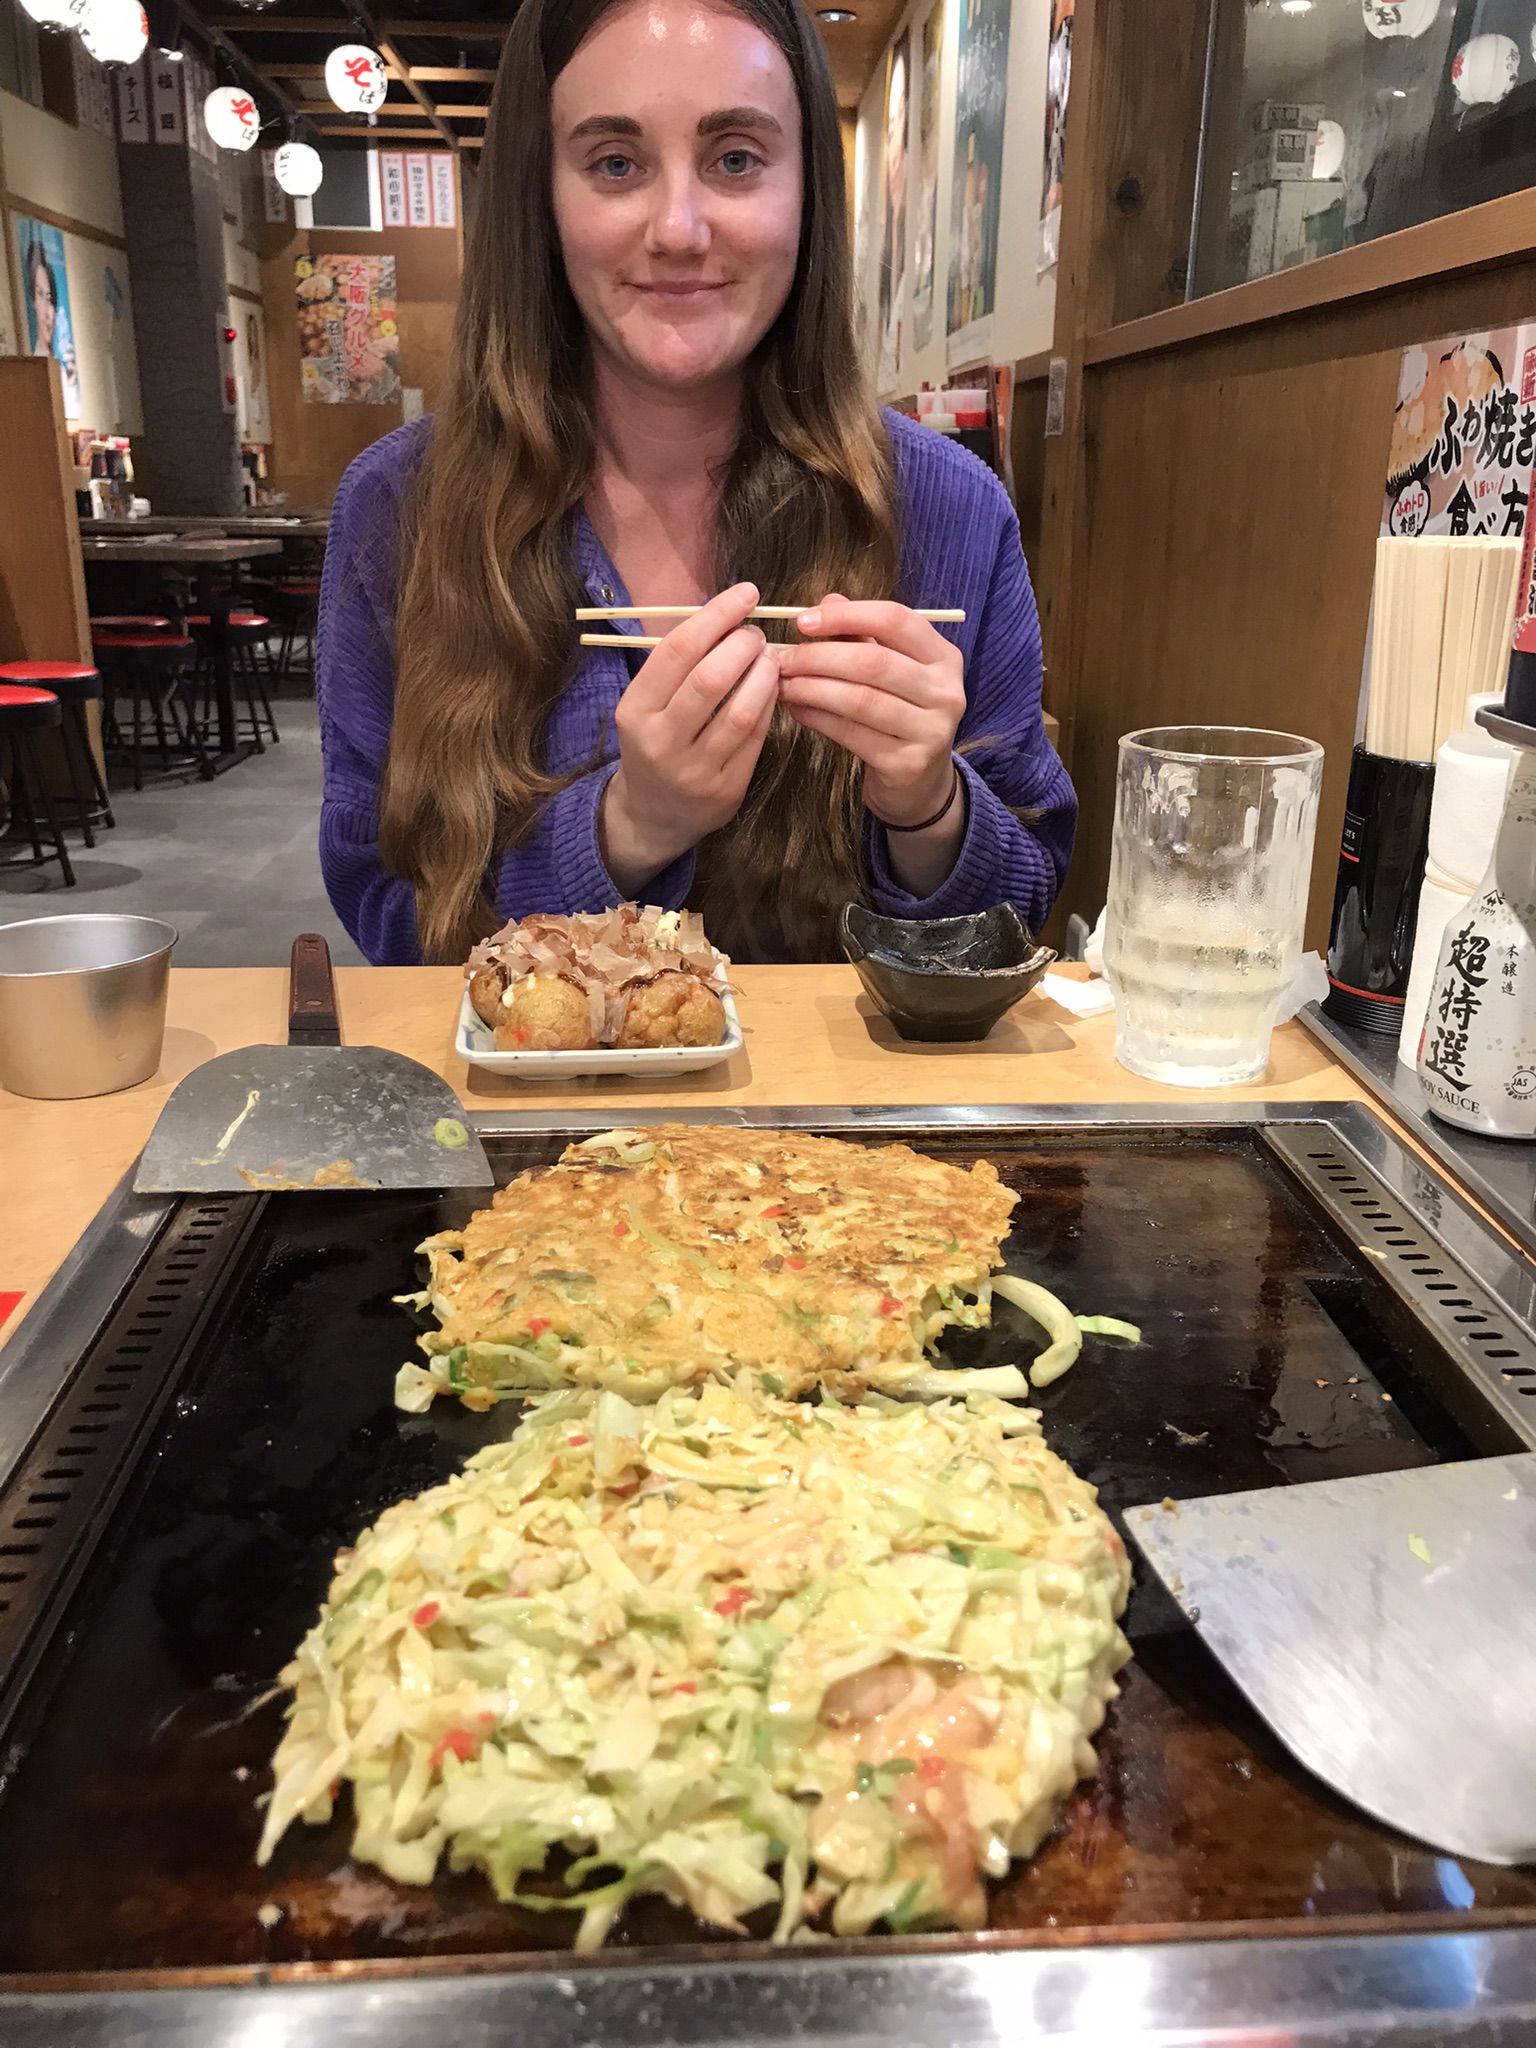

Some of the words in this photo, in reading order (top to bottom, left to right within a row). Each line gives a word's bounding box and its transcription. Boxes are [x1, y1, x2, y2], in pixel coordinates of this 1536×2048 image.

[350, 264, 366, 368] 大阪グルメ
[1446, 478, 1528, 537] 食べ方
[1501, 943, 1520, 997] 本醸造
[1425, 920, 1491, 1092] 超特選
[1437, 1086, 1480, 1114] SAUCE
[1511, 1077, 1528, 1087] JAS
